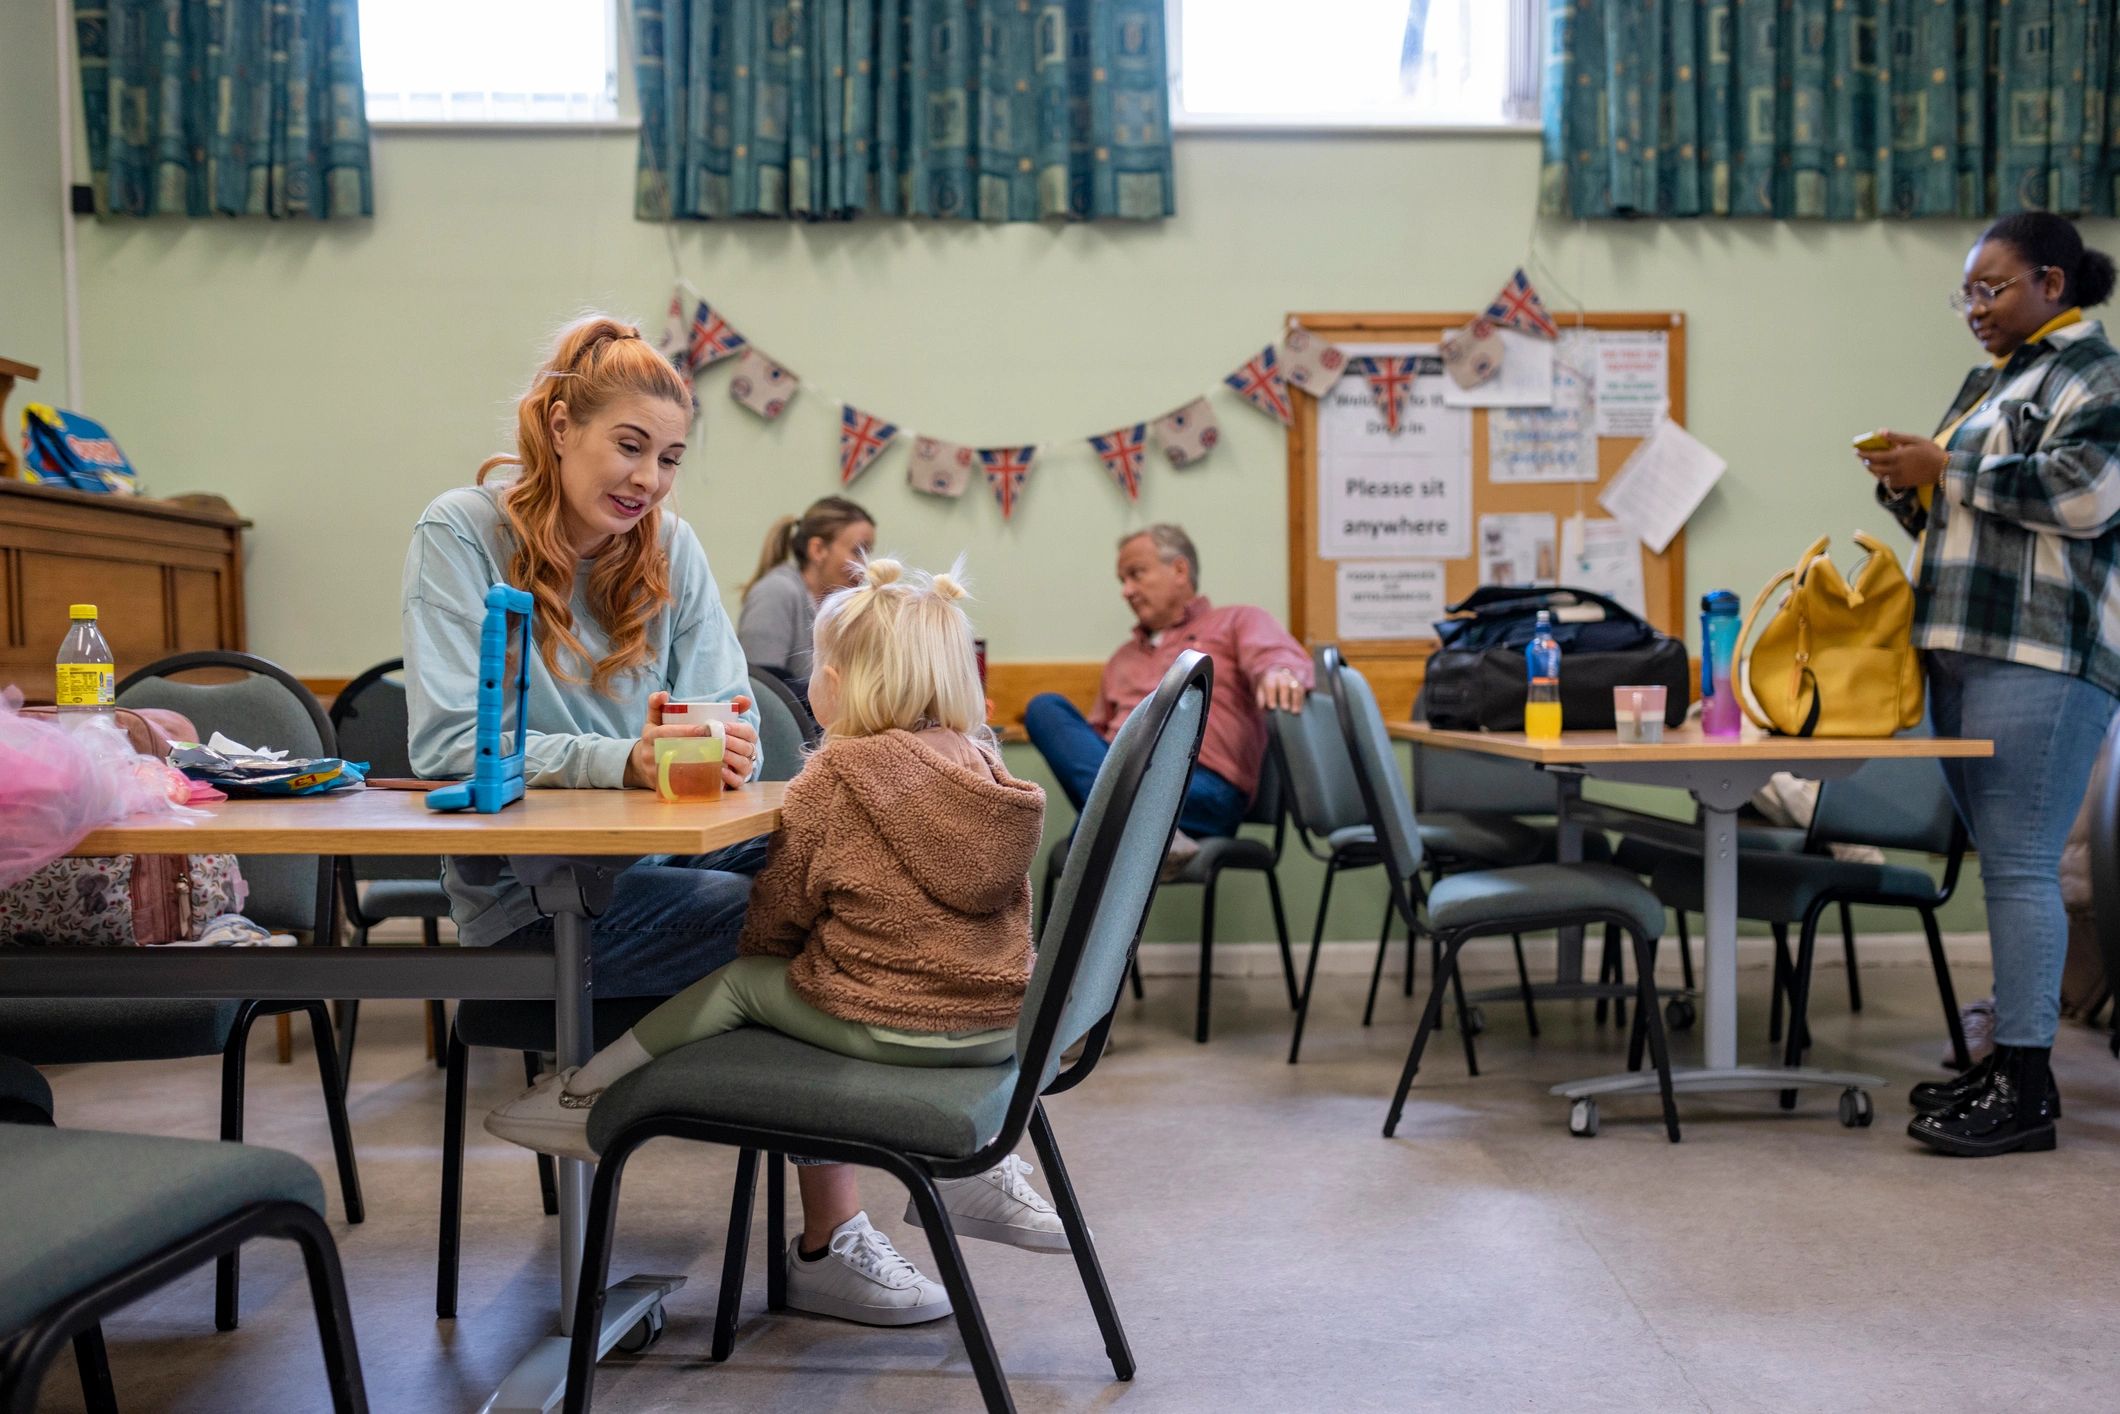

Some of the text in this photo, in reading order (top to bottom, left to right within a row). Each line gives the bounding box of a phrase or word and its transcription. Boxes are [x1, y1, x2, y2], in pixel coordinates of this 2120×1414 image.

[1346, 477, 1445, 497] Please sit
[1344, 514, 1447, 539] anywhere
[294, 774, 317, 787] £1
